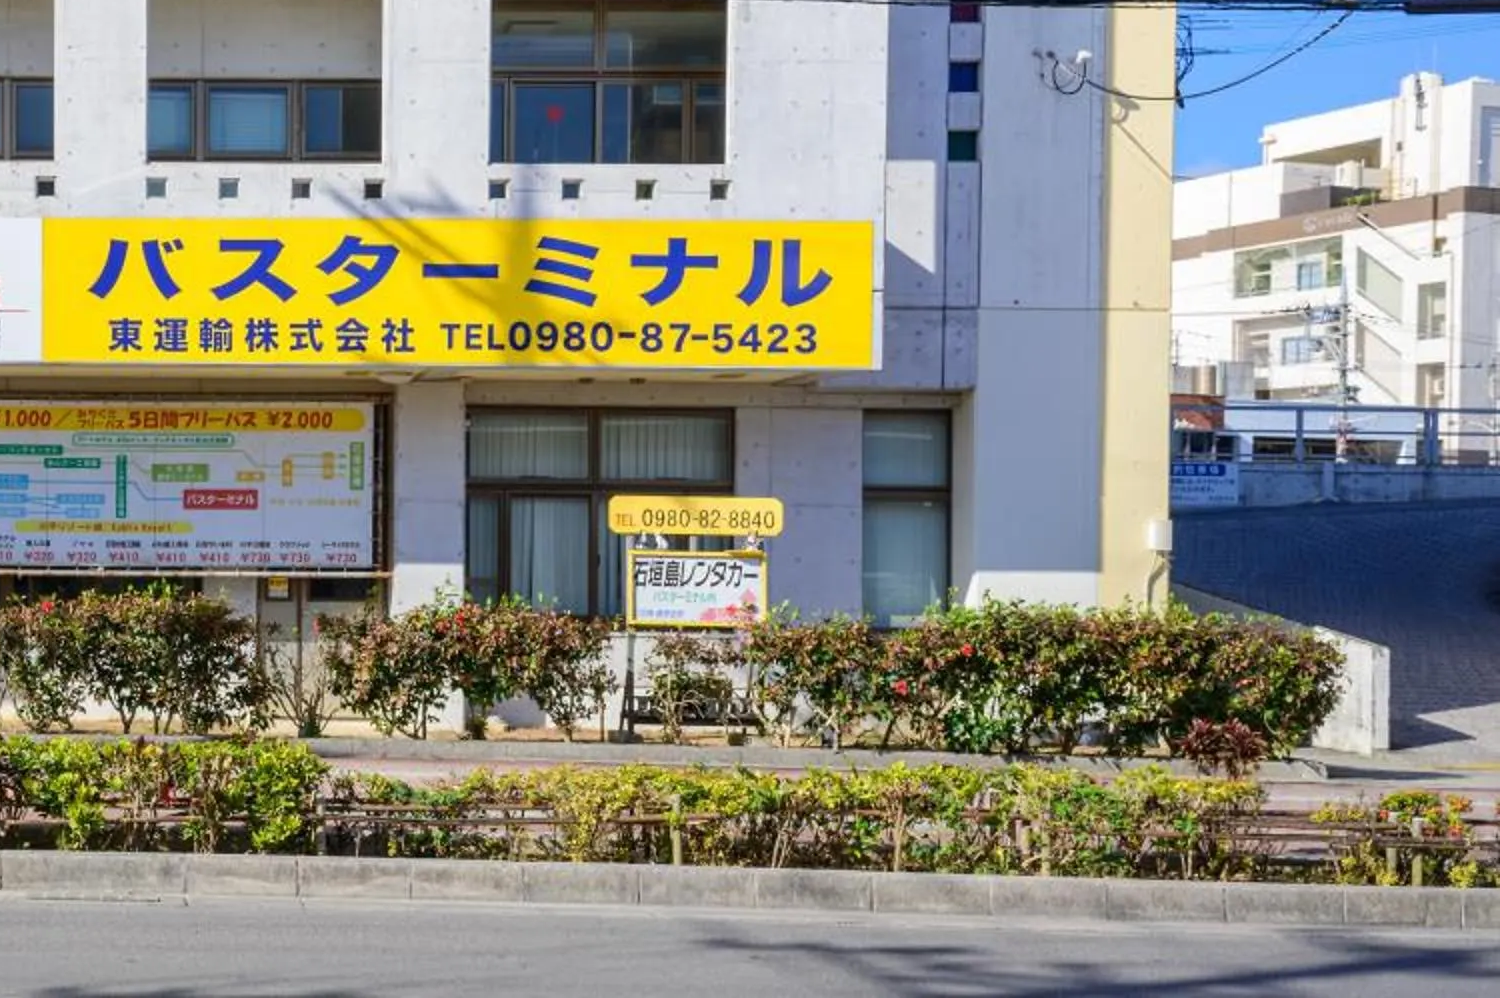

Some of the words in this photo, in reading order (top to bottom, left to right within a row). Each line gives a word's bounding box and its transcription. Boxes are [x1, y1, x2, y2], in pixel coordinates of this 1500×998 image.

[87, 234, 834, 307] バスターミナル
[108, 318, 415, 353] 東運輸株式会社
[186, 492, 255, 506] バスターミナル
[615, 514, 636, 527] TEL
[641, 509, 775, 529] 0980-82-8840
[634, 560, 758, 587] 石垣島レンタカー
